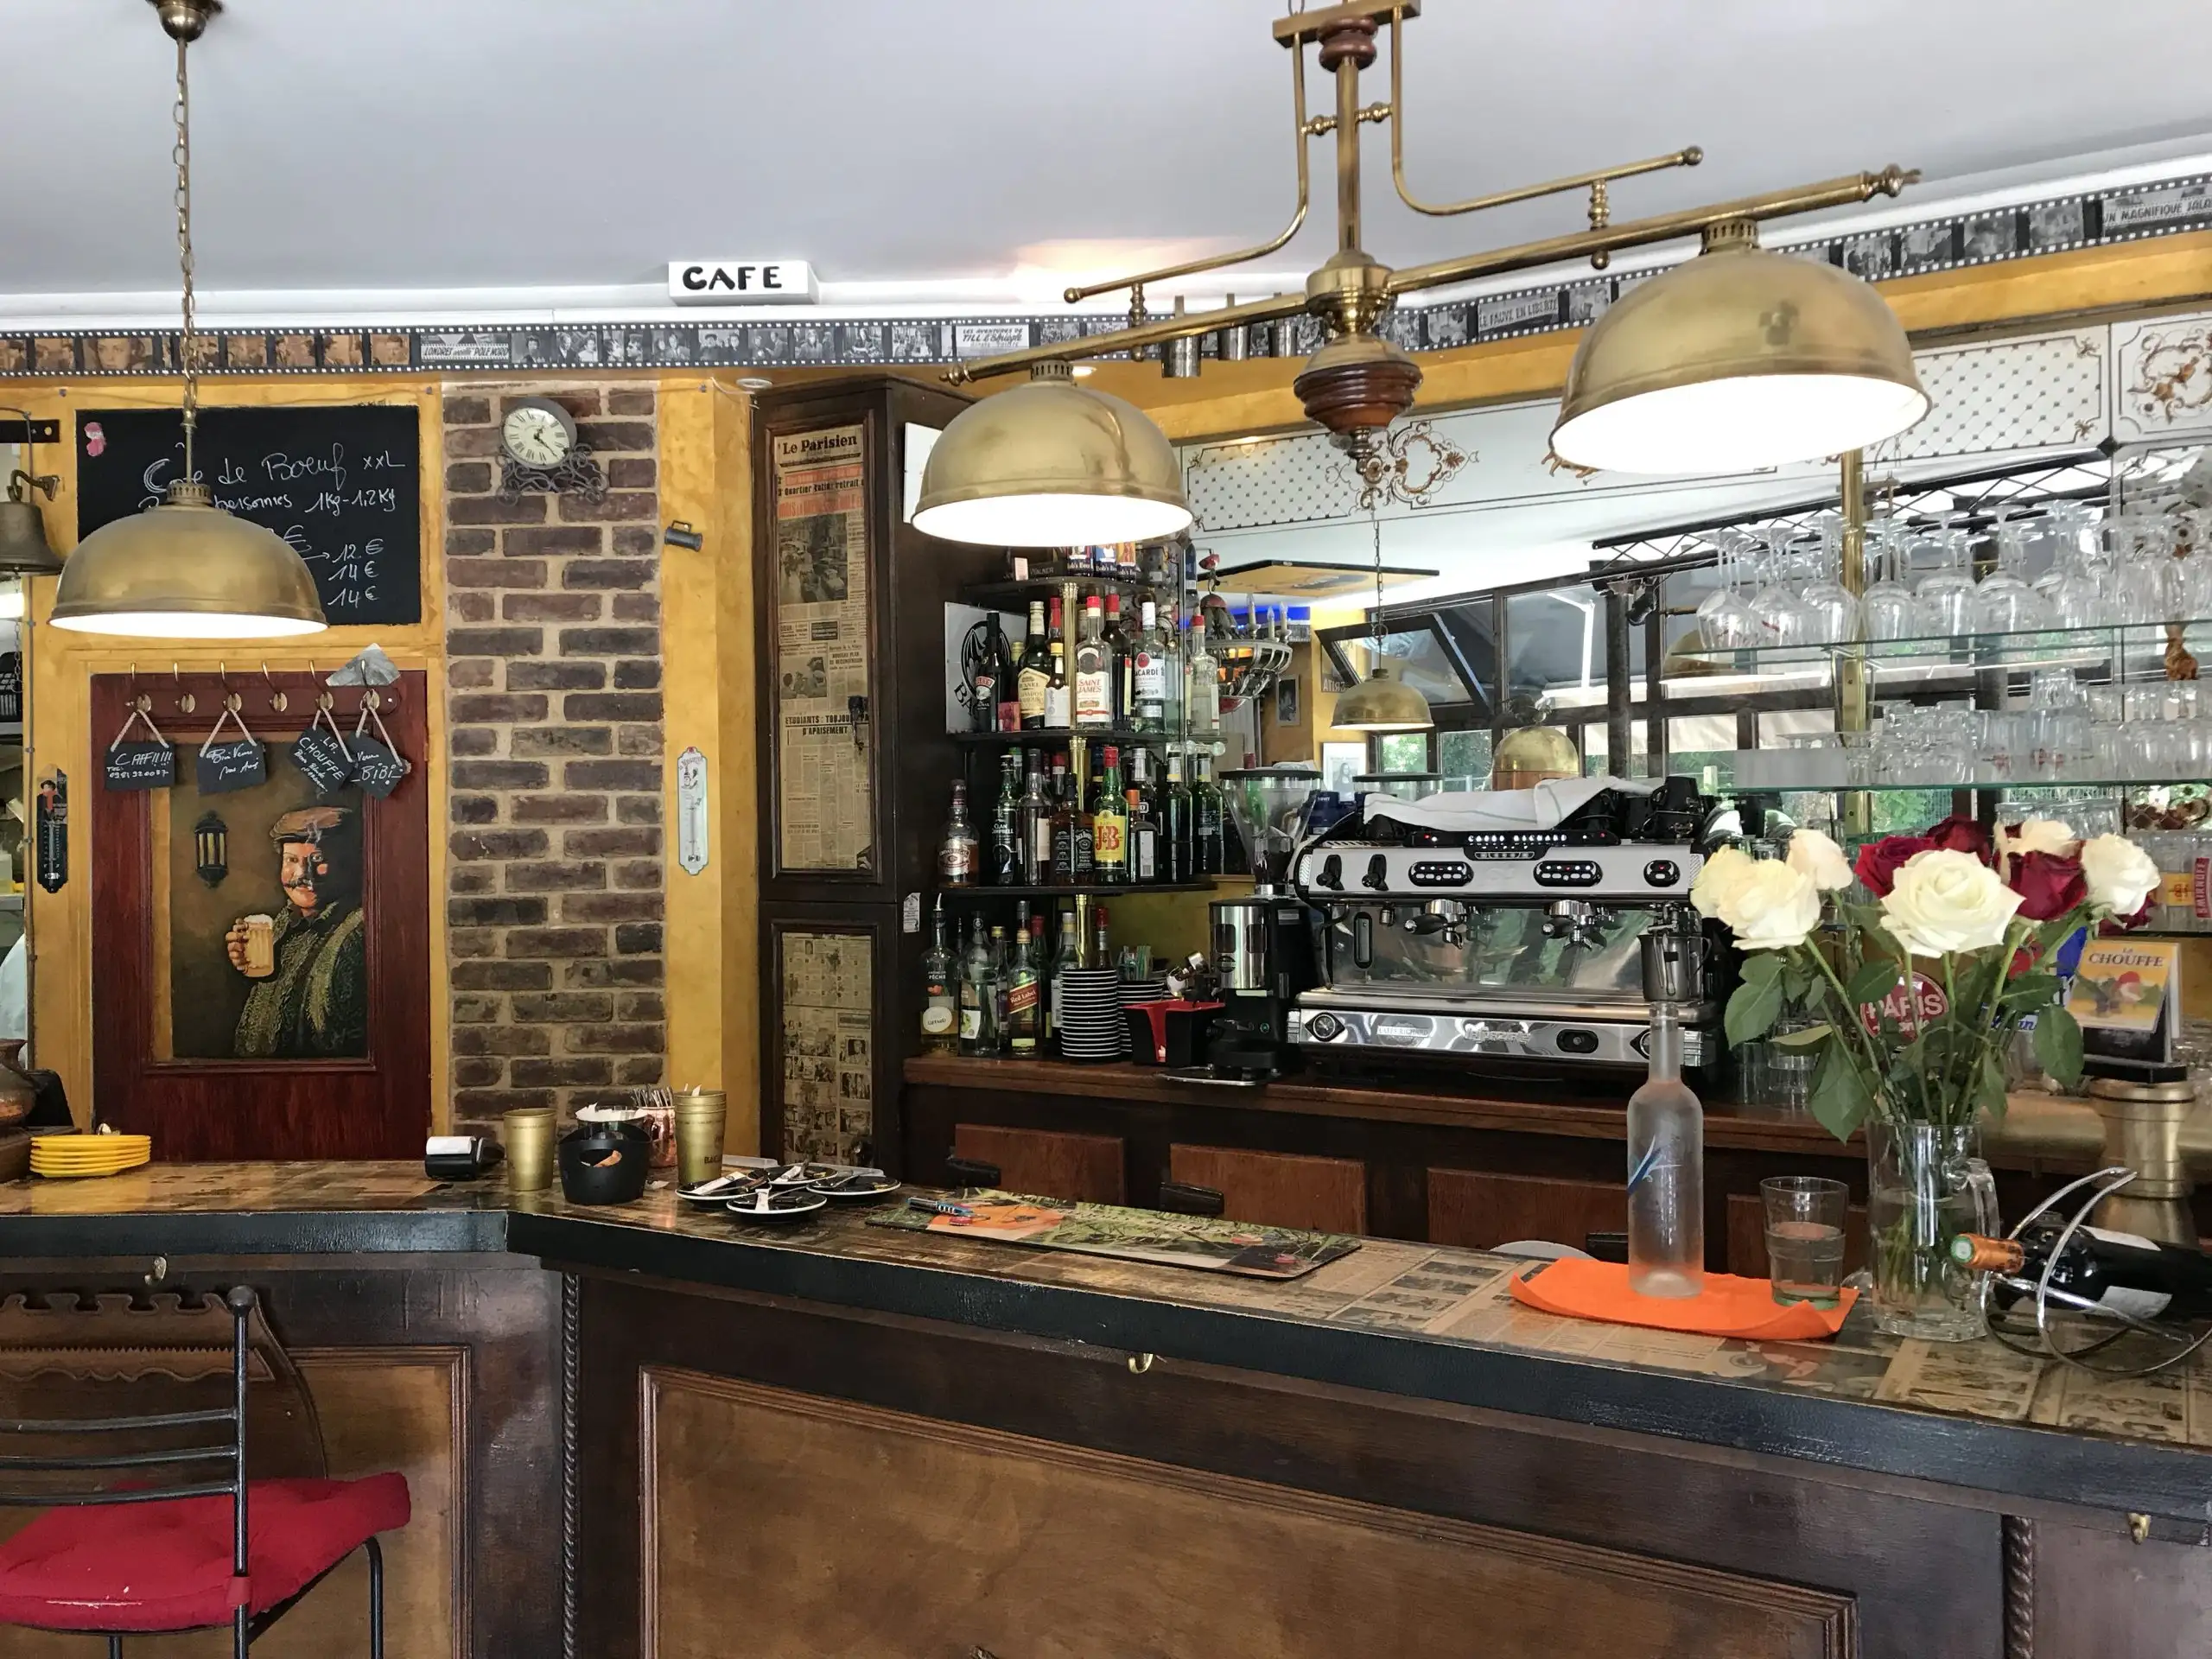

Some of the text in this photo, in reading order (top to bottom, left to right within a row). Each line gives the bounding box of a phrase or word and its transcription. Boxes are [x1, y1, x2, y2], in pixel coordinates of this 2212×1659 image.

[2121, 202, 2183, 220] MAGNIFIQUE
[682, 265, 783, 291] CAFE
[783, 434, 858, 455] Le Parisien
[218, 457, 247, 486] de
[365, 537, 384, 556] €
[328, 560, 380, 582] 14 €
[327, 585, 381, 608] 14 €
[1078, 678, 1102, 687] SAINT
[802, 726, 849, 736] D'APAISEMENT
[299, 737, 345, 780] CHOUFFE
[1095, 825, 1120, 851] J&B
[2088, 952, 2166, 967] CHOUFFE
[1010, 988, 1037, 1004] Red Label
